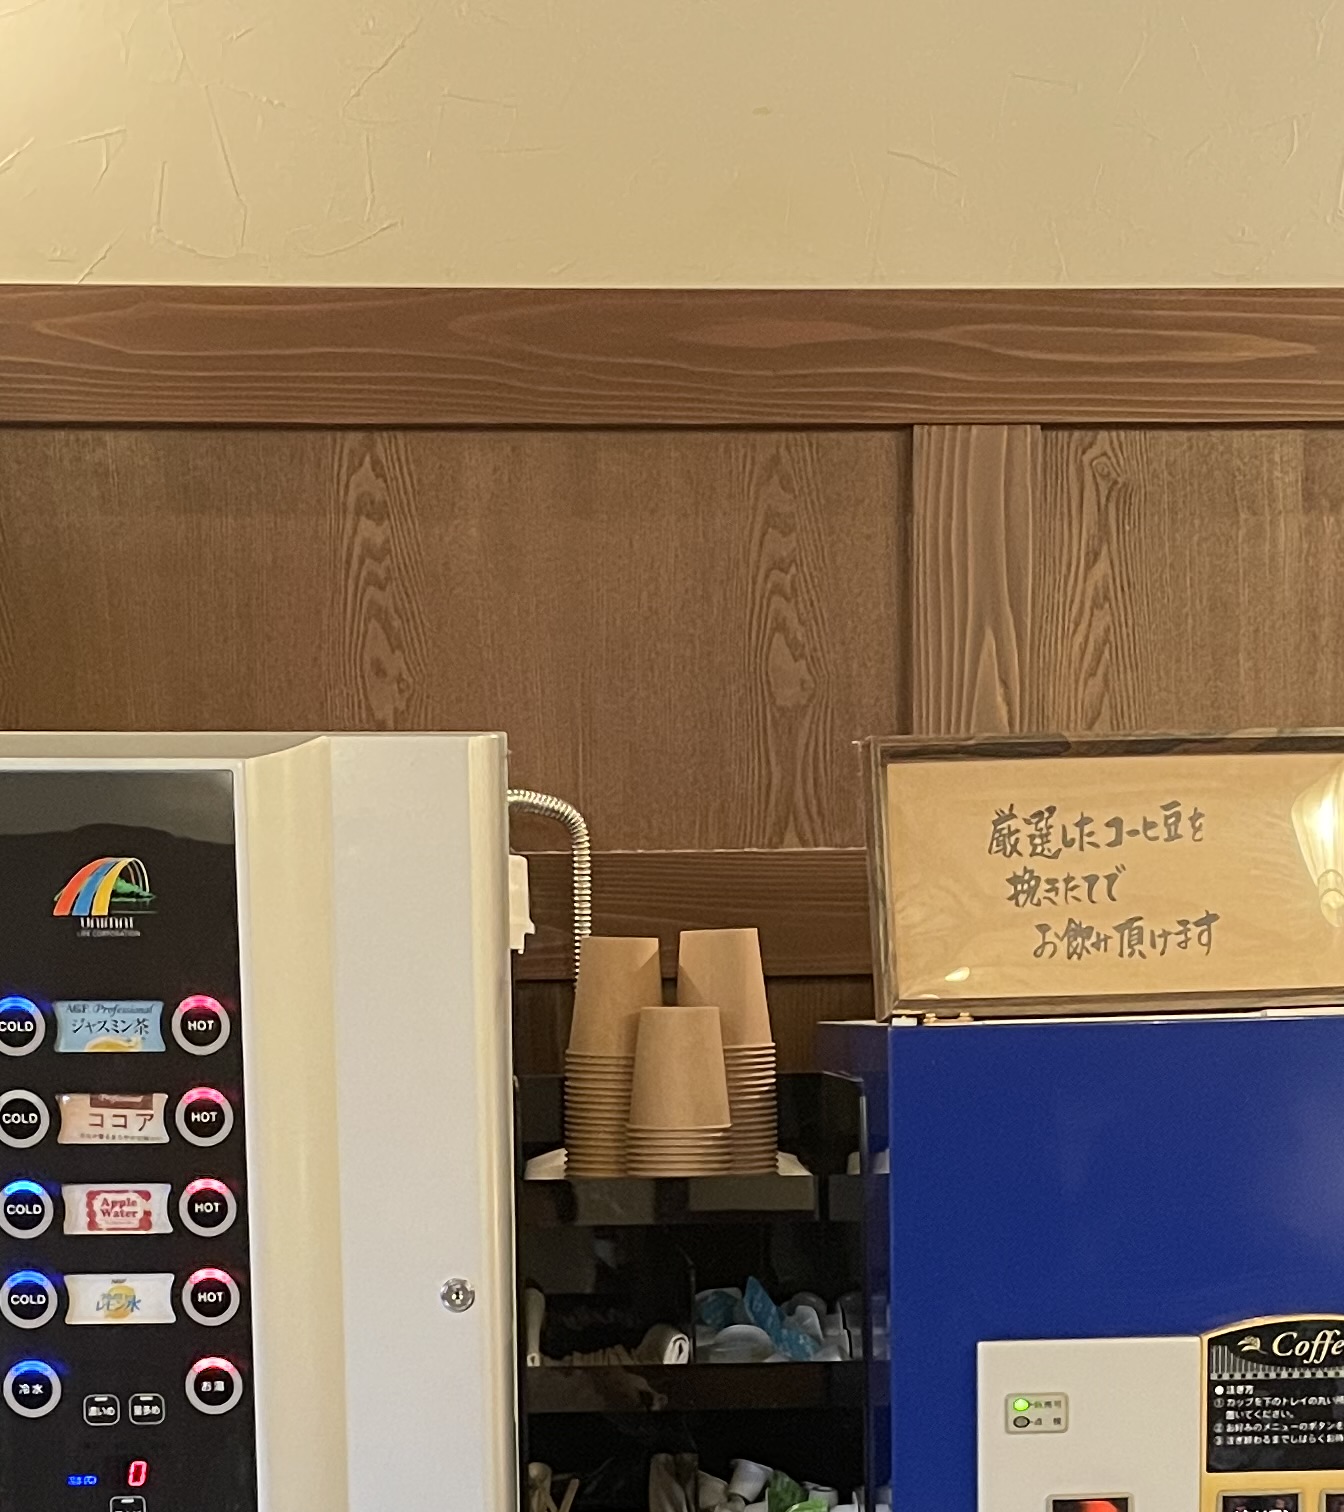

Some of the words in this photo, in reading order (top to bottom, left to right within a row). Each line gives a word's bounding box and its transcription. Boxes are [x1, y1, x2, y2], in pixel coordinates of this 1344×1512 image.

[988, 800, 1205, 860] 厳選したコーヒ豆を
[1006, 864, 1127, 908] 挽きたてで
[1033, 910, 1220, 960] お飲み頂けます
[72, 1018, 149, 1035] ジャスミン茶
[187, 1019, 215, 1032] HOT
[2, 1112, 38, 1125] COLD
[89, 1113, 154, 1131] ココア
[191, 1111, 218, 1123] HOT
[6, 1203, 42, 1216] COLD
[101, 1197, 137, 1210] Apple
[194, 1201, 221, 1214] HOT
[100, 1209, 138, 1218] Water
[10, 1294, 46, 1306] COLD
[197, 1291, 223, 1304] HOT
[128, 1461, 148, 1487] 0
